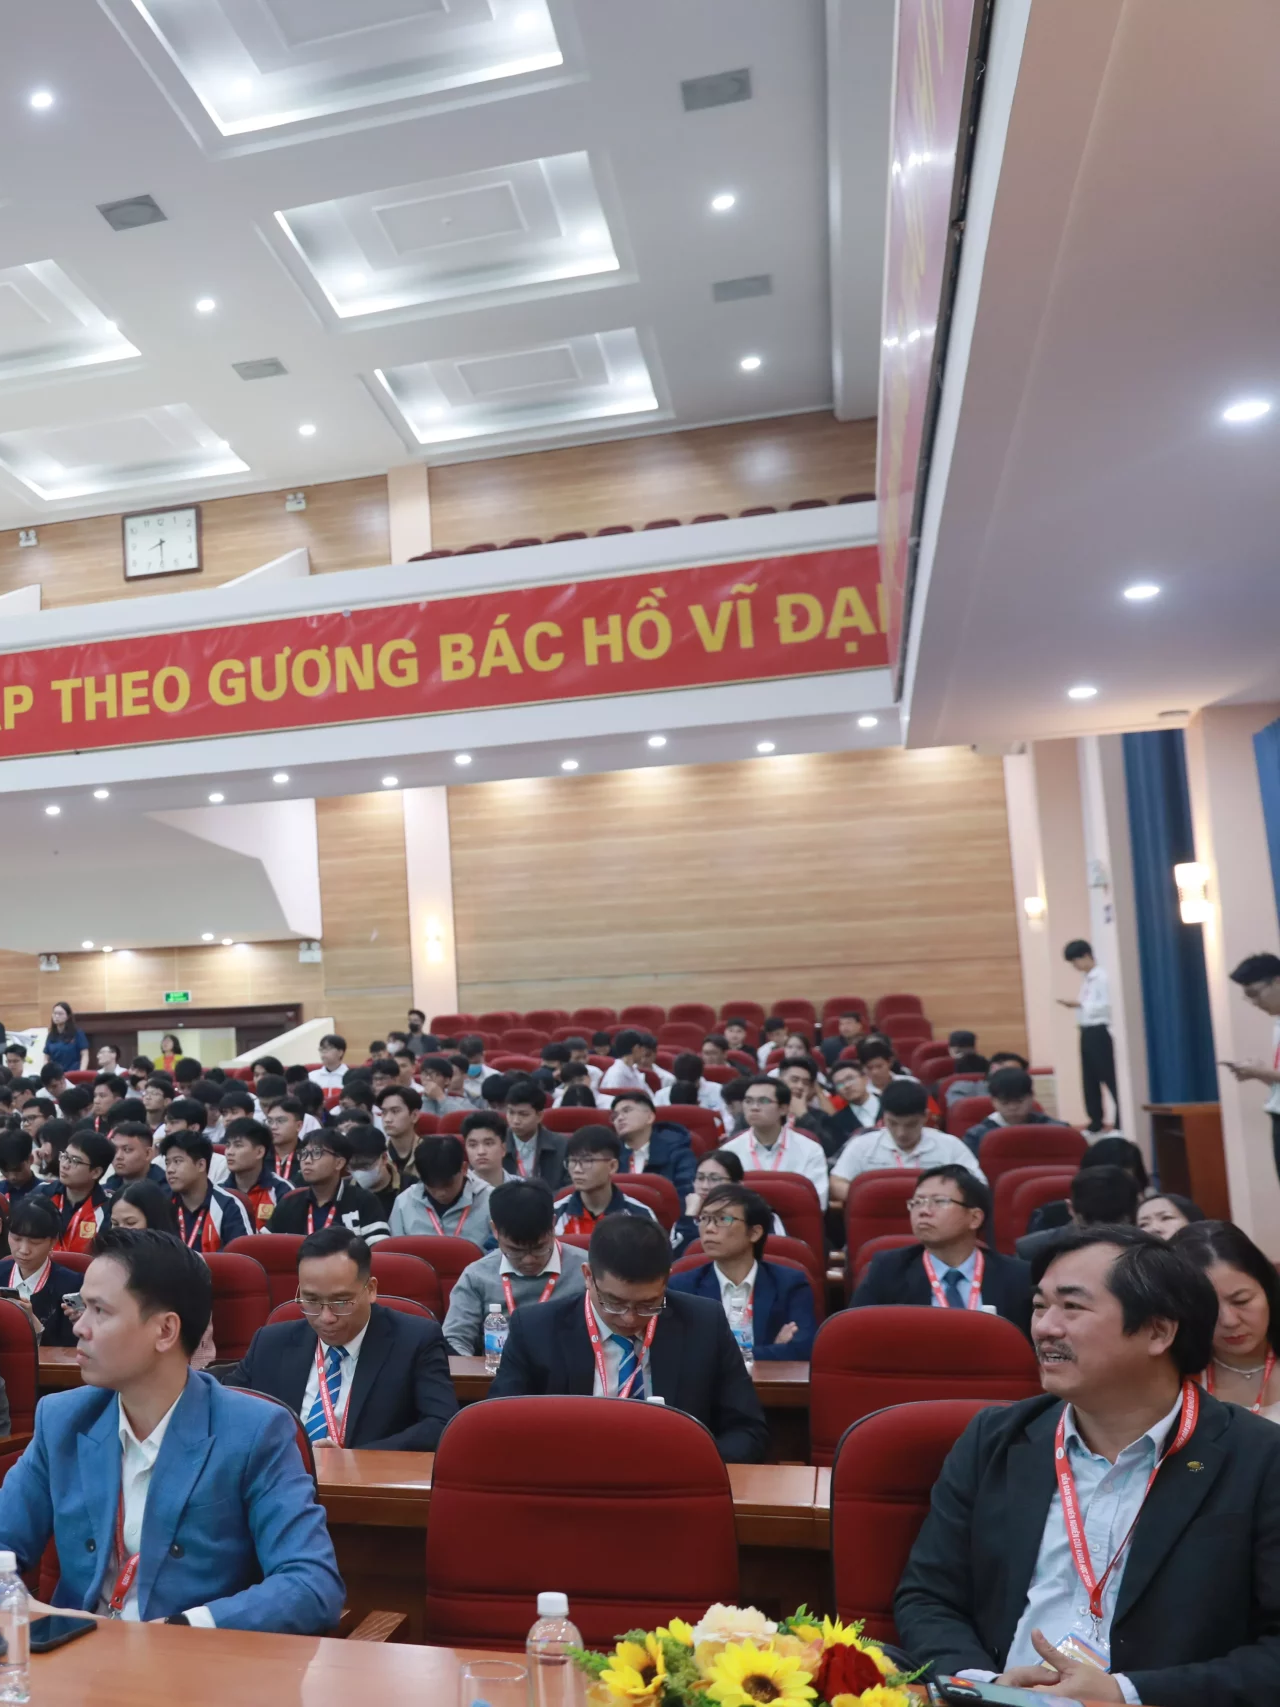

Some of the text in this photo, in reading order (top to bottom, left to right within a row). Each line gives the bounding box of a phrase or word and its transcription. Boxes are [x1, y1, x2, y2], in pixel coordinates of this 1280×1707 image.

[51, 666, 190, 722] THEO
[209, 639, 419, 705] GƯƠNG
[440, 614, 564, 681] BÁC
[583, 588, 671, 665] HỒ
[690, 584, 756, 651] VĨ
